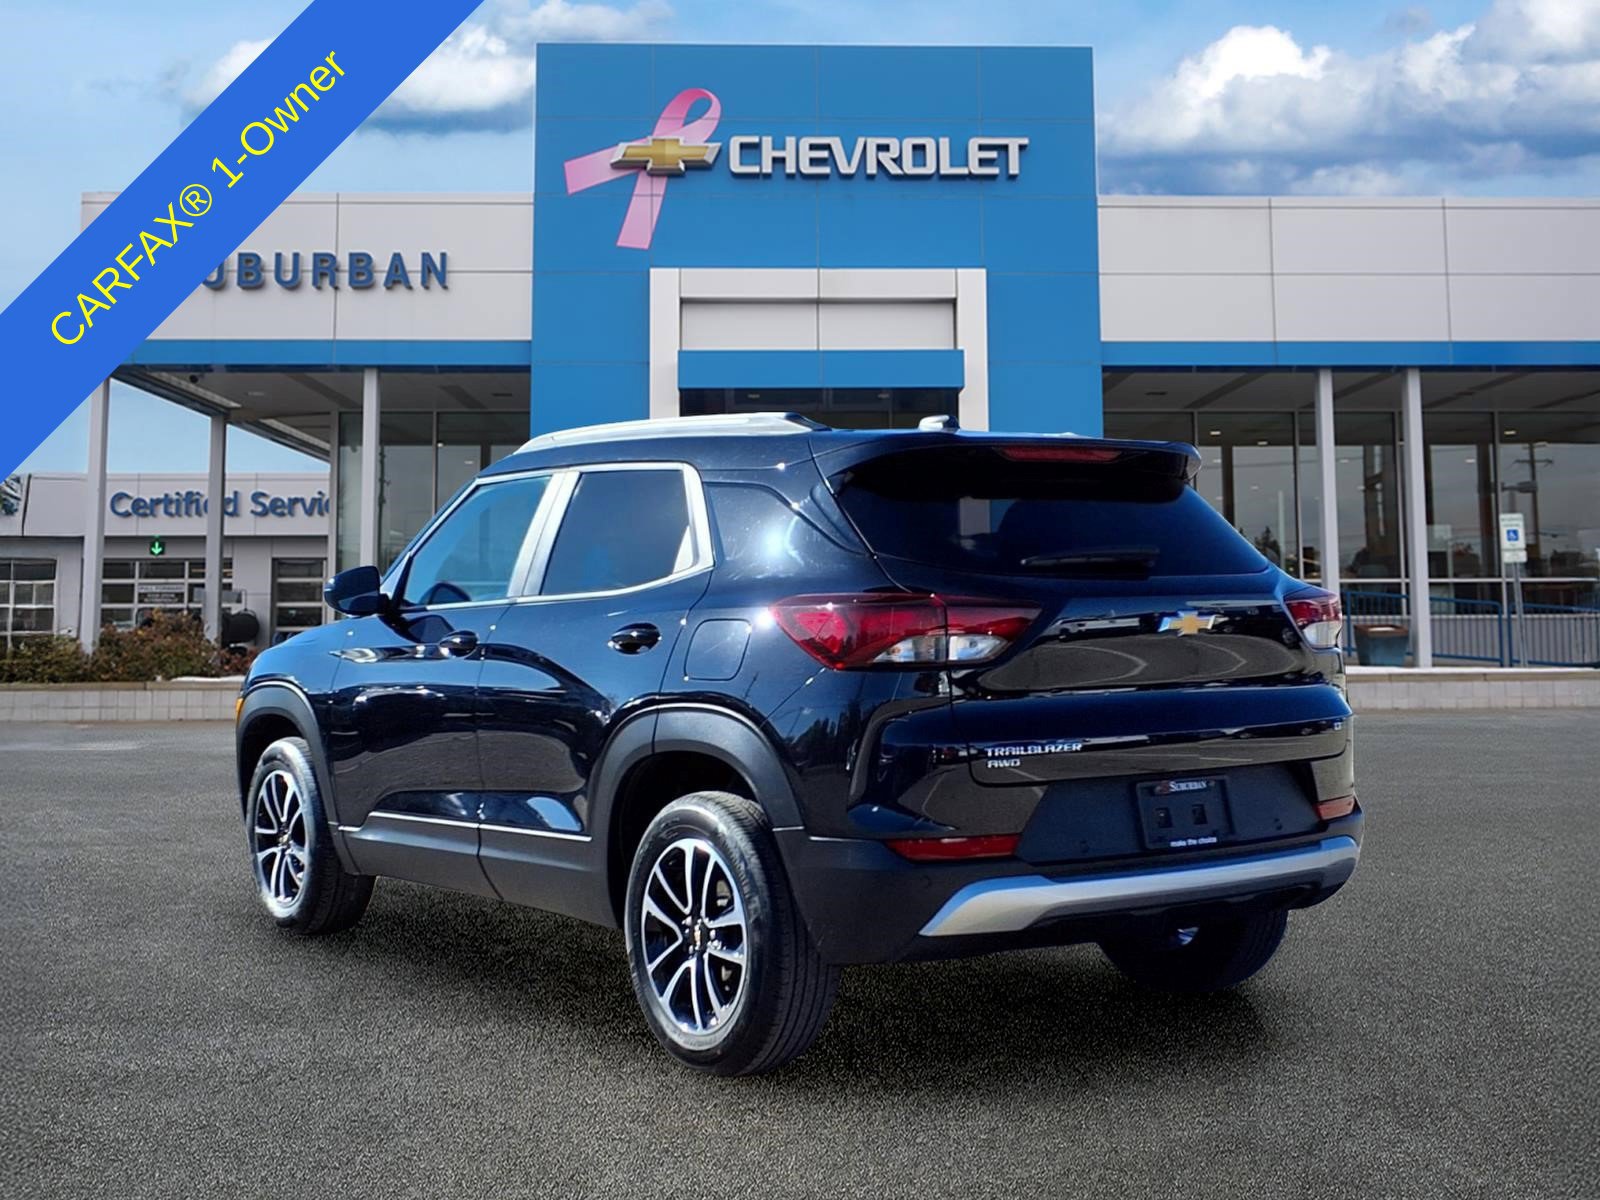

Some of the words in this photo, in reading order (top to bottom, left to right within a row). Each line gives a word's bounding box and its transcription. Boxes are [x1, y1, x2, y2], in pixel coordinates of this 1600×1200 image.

[729, 135, 1029, 177] CHEVROLET
[202, 252, 448, 289] UBURBAN
[250, 491, 329, 517] Servi
[984, 743, 1083, 757] TRAILBLAZER
[987, 759, 1021, 768] AWD
